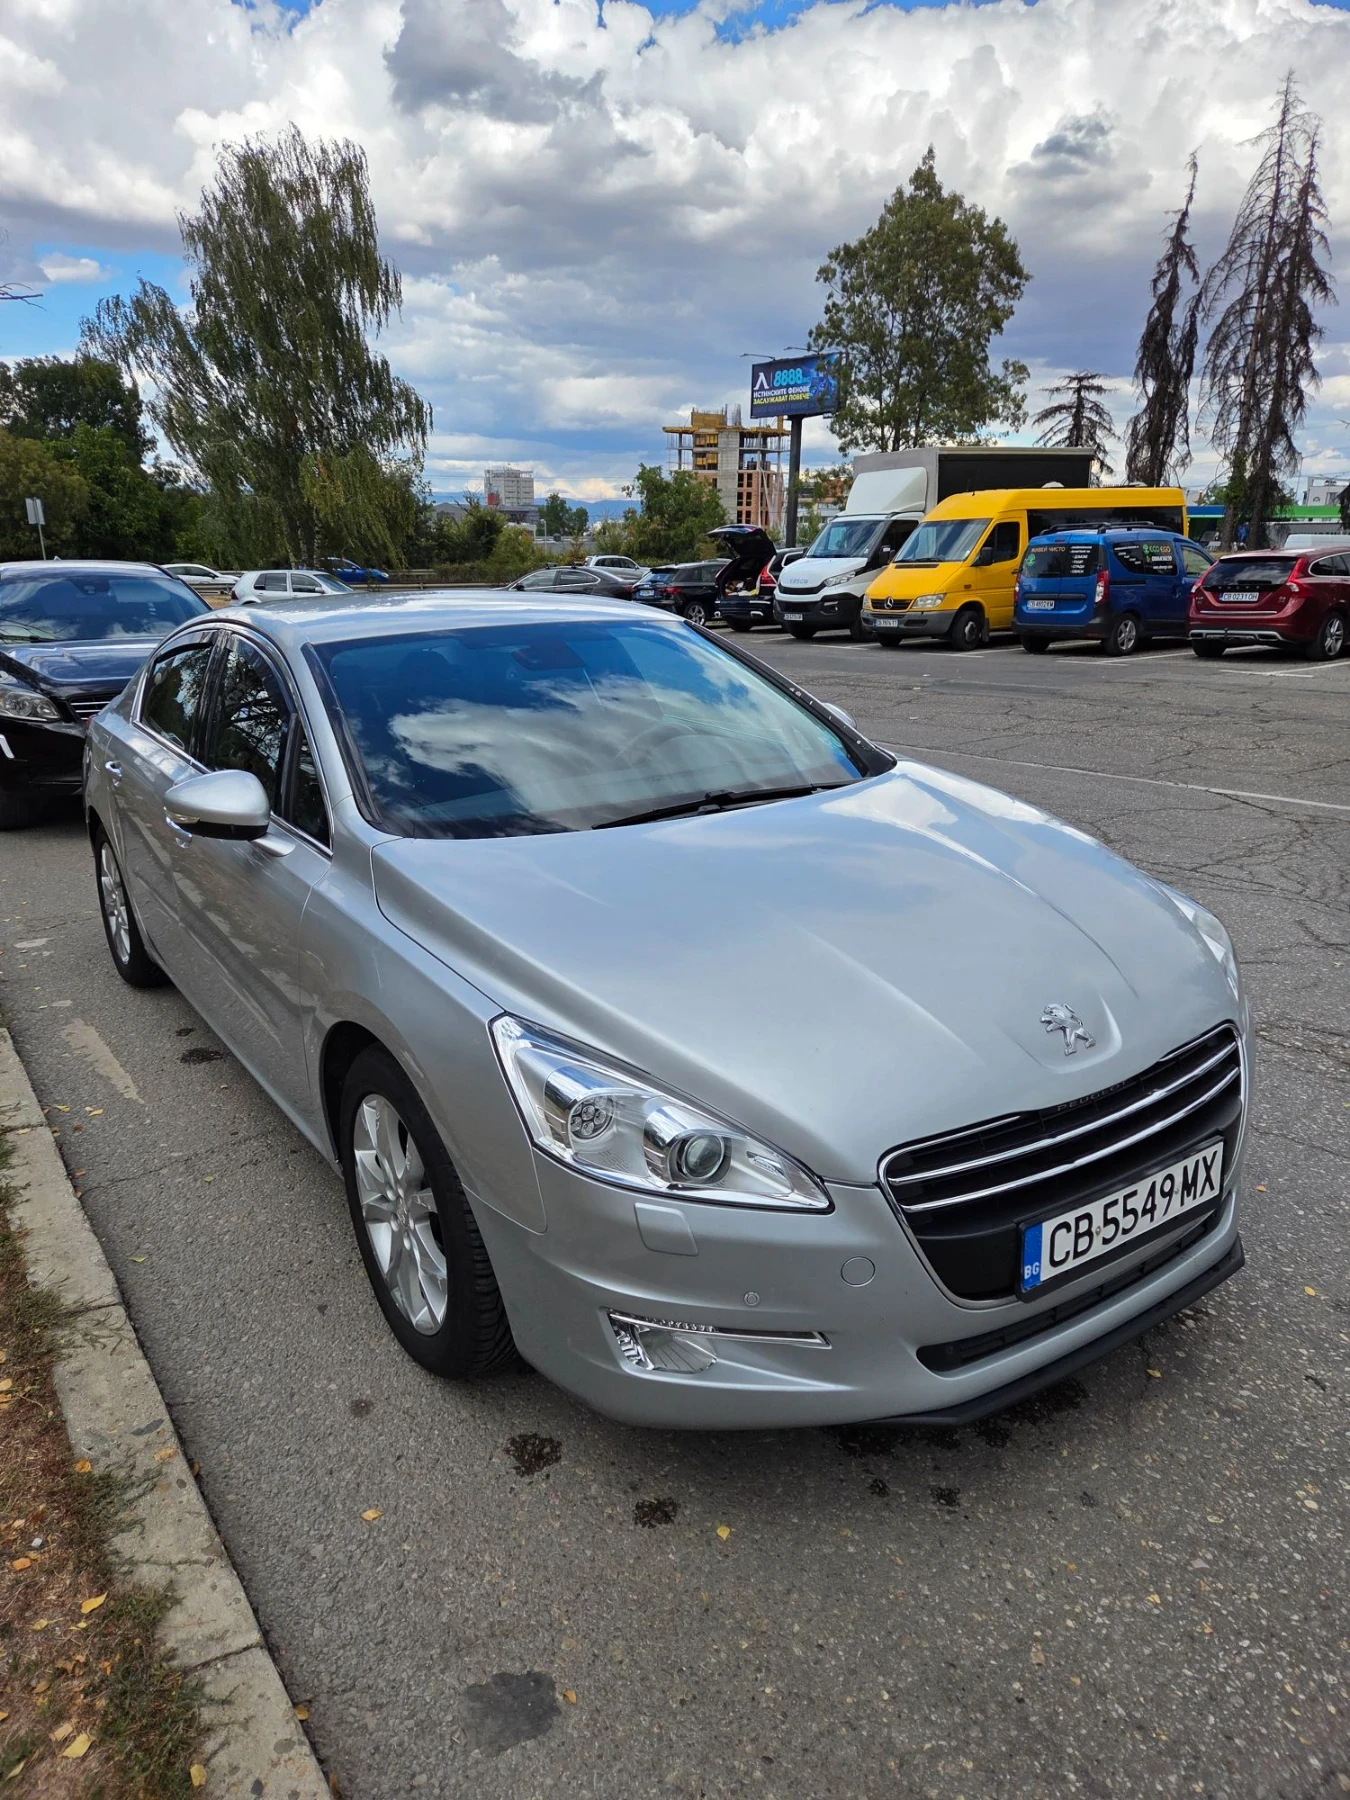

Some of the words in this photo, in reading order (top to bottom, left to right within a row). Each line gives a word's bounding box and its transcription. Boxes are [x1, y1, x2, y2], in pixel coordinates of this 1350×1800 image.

[753, 395, 788, 405] ЗАСЛУЖАВАТ
[789, 392, 810, 401] ПОВЕЧЕ
[1049, 1212, 1094, 1267] CB
[1102, 1173, 1175, 1245] 5549
[1180, 1150, 1218, 1207] MX
[1024, 1262, 1040, 1279] BG
